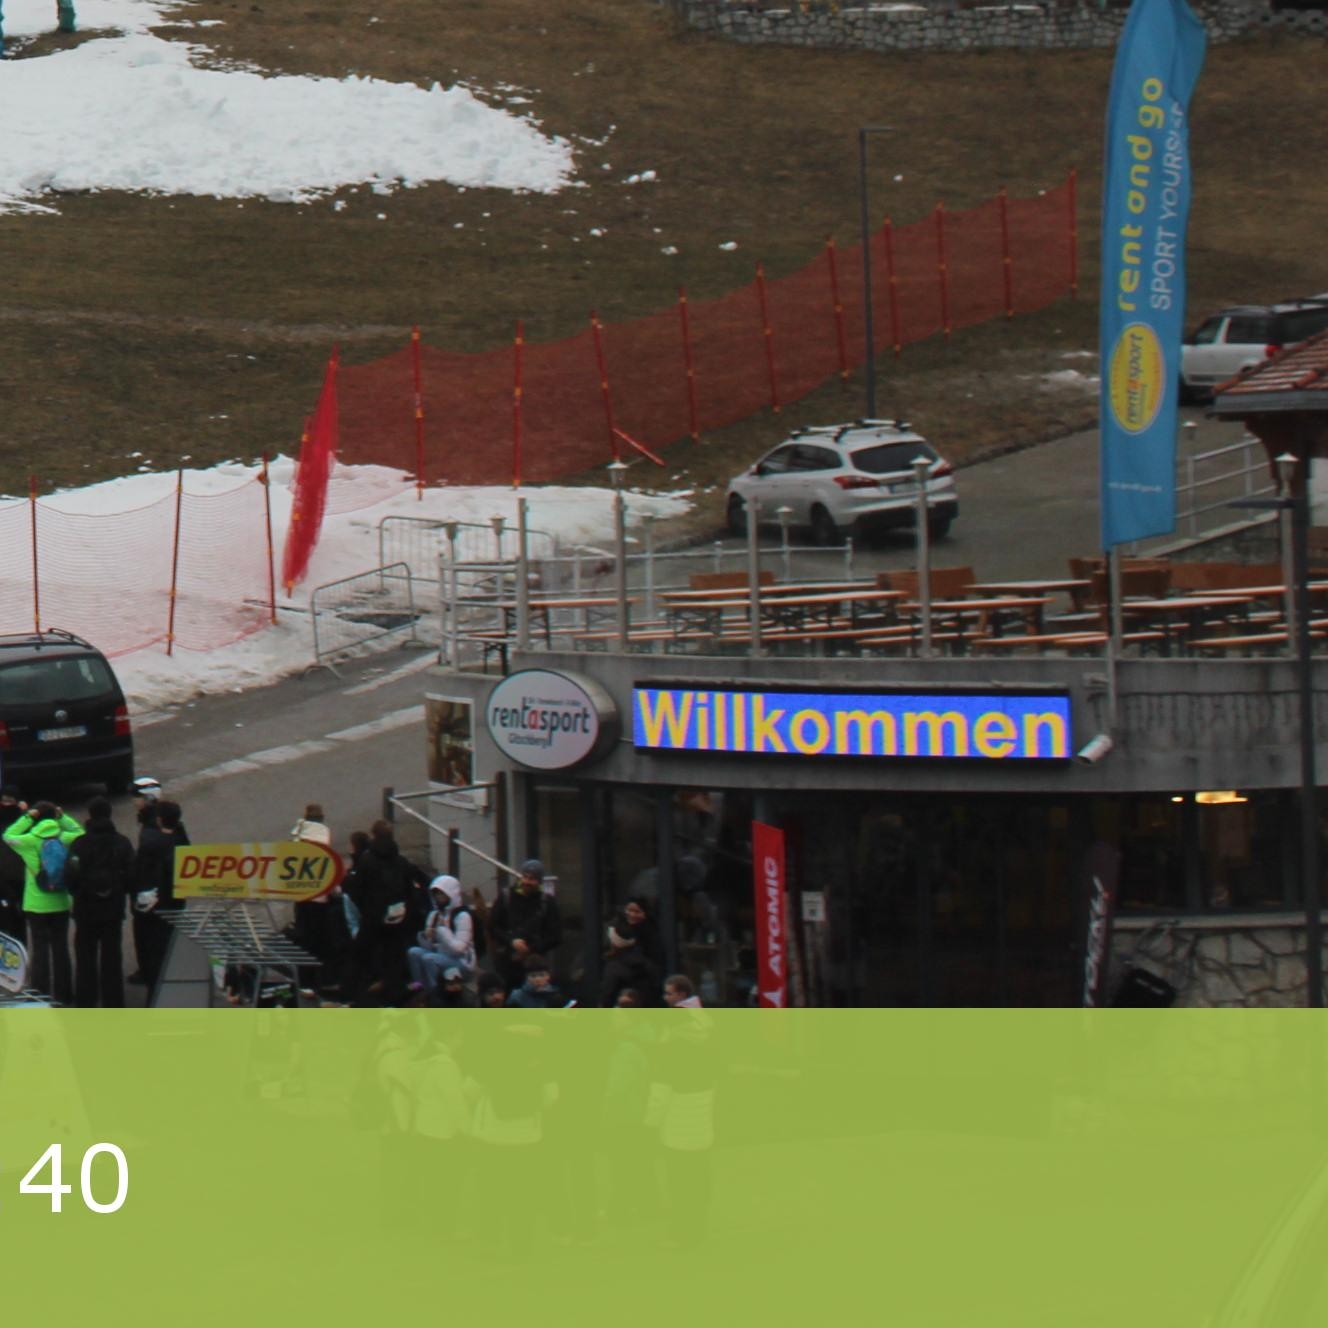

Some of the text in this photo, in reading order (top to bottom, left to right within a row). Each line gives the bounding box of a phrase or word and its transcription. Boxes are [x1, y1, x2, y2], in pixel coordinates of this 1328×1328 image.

[1117, 78, 1165, 312] rent and go
[1150, 226, 1177, 311] SPORT
[492, 696, 590, 747] rentasport
[637, 690, 1066, 758] Willkommen
[179, 855, 329, 881] DEPOT SKI
[764, 856, 781, 976] ATOMIC
